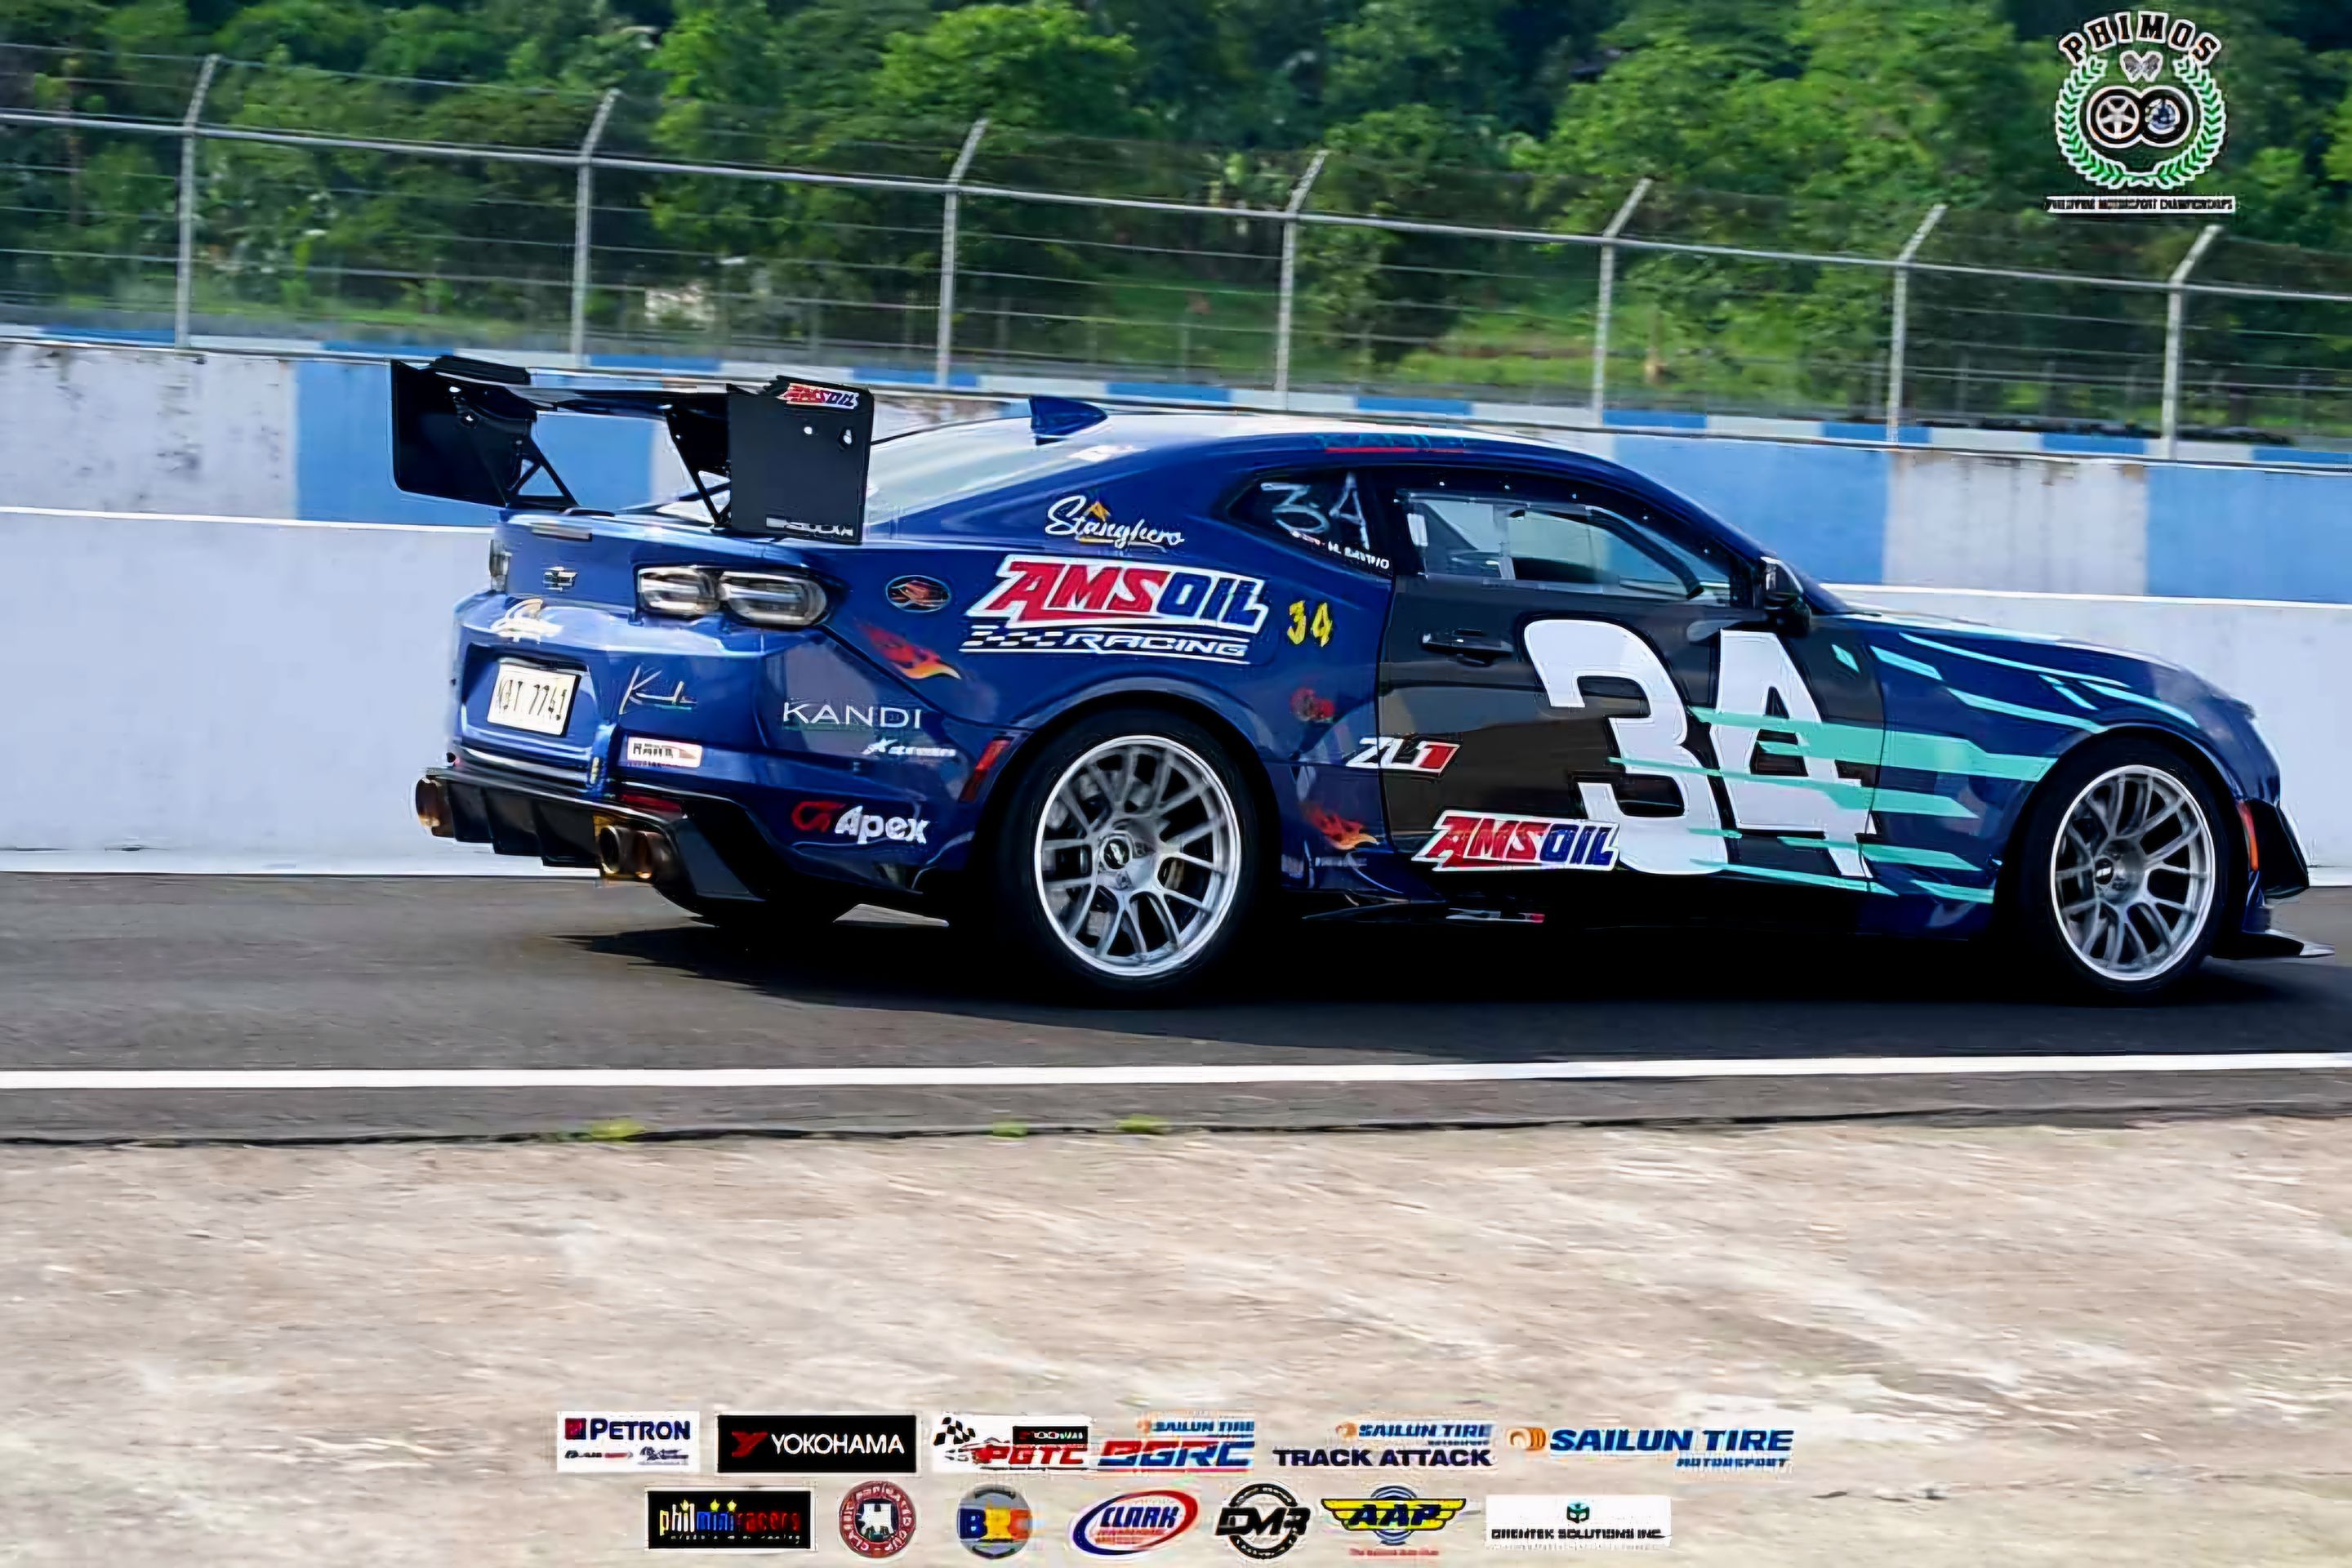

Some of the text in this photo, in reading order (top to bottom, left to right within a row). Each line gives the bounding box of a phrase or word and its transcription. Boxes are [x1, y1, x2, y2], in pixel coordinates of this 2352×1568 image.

[779, 383, 859, 409] ASOIL
[967, 555, 1269, 633] AMSOIL
[1063, 632, 1249, 657] RACING
[1287, 600, 1333, 647] 34
[783, 702, 921, 728] KANDI
[1524, 619, 1877, 878] 34
[835, 804, 930, 844] Apex
[1412, 809, 1619, 871] AMSOIL
